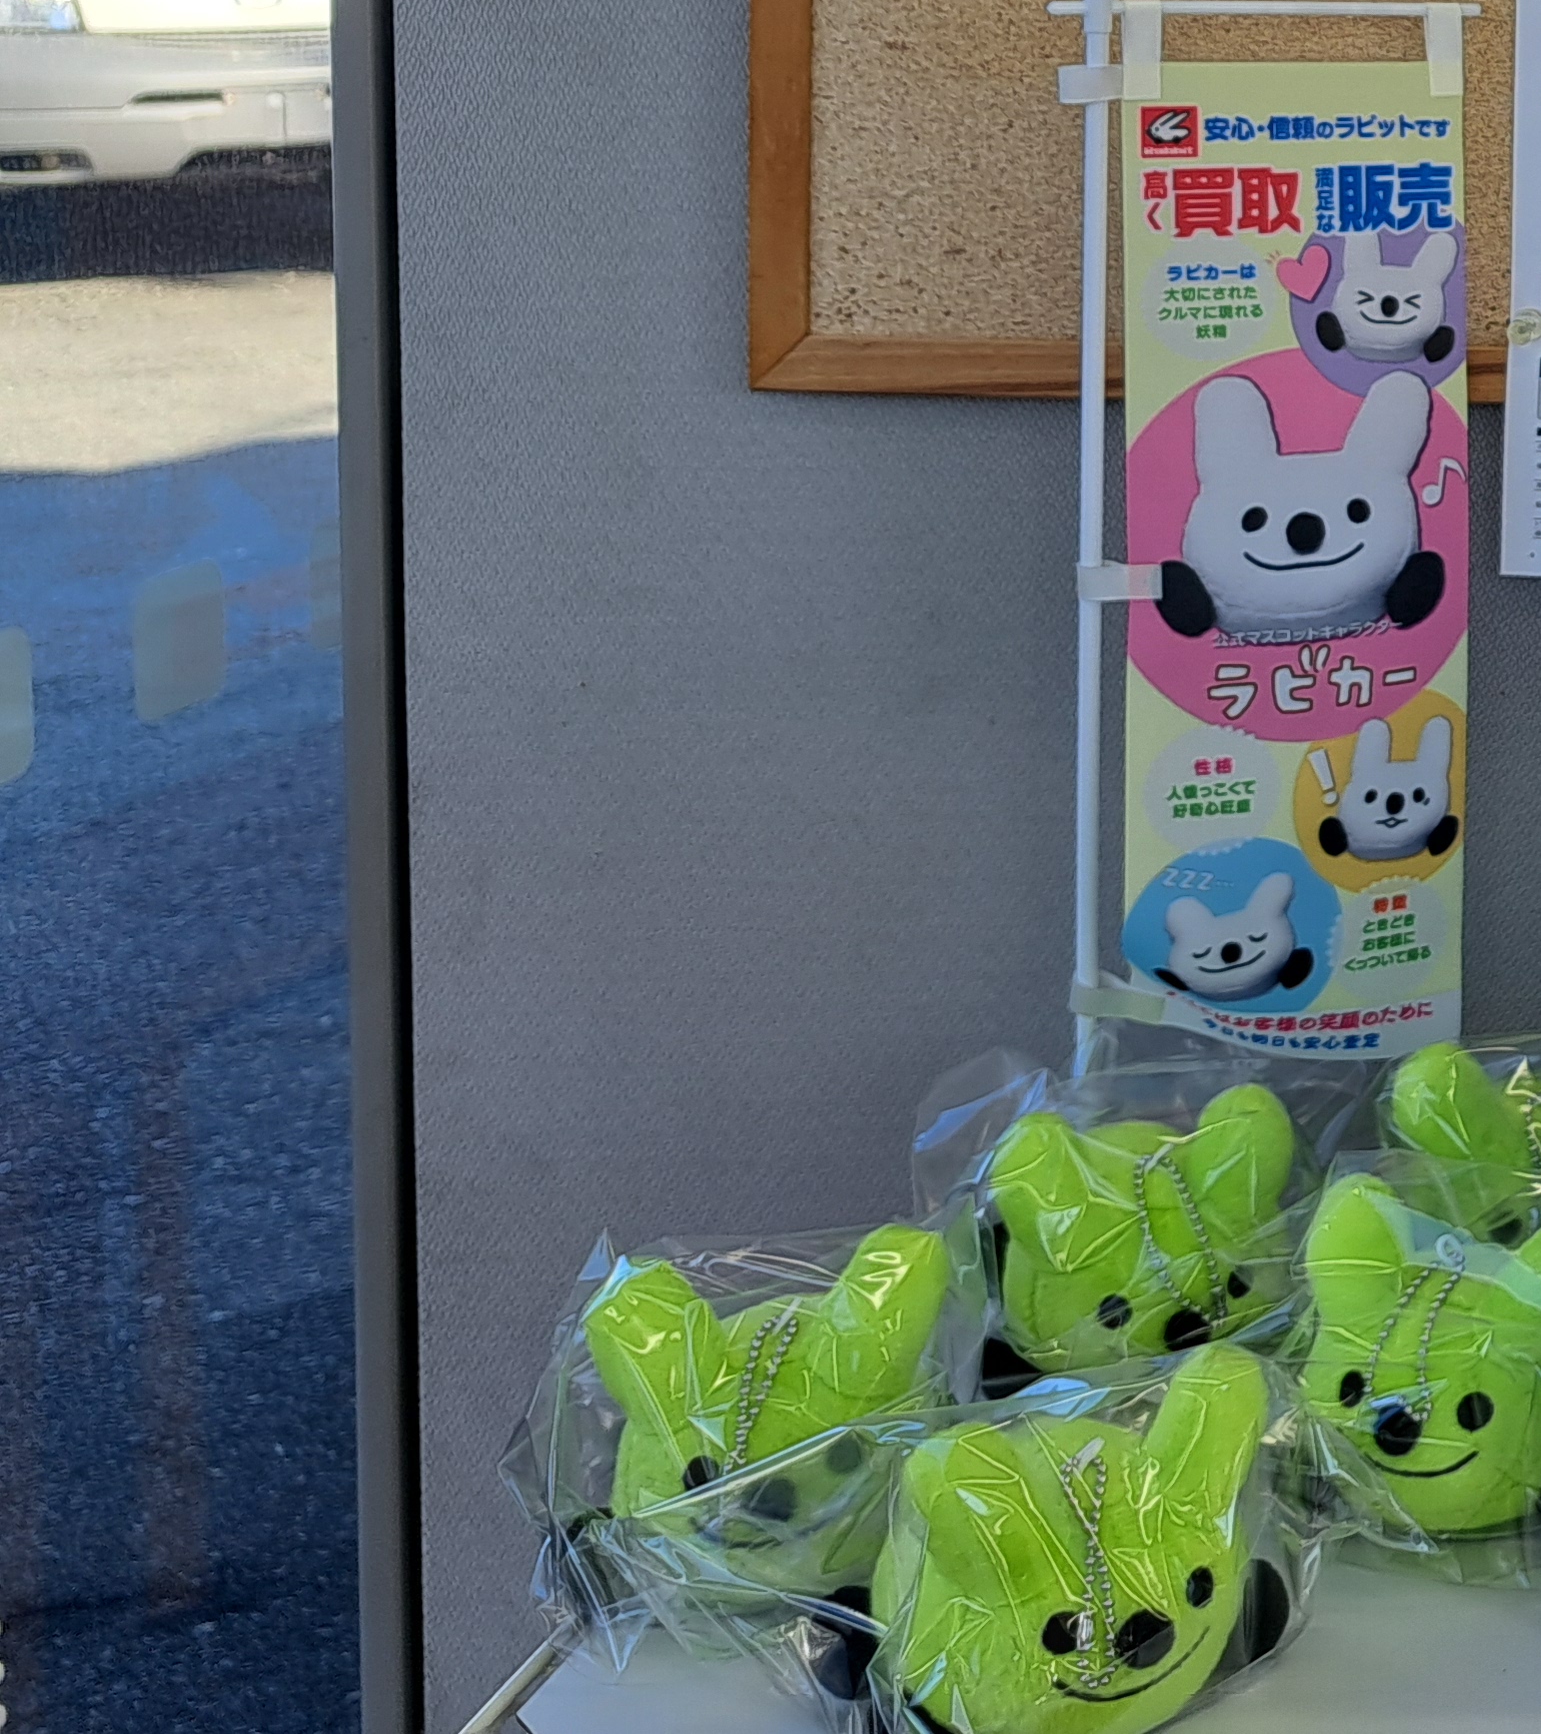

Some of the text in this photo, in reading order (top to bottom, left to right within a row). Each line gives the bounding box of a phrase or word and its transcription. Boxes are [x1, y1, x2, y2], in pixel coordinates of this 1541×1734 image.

[1204, 115, 1450, 140] 安心・信頼のラビットです
[1173, 168, 1300, 237] 買取
[1167, 265, 1256, 281] ラビカーは
[1212, 620, 1403, 649] 公式マスコットキャラクター
[1208, 645, 1416, 719] ラビカー
